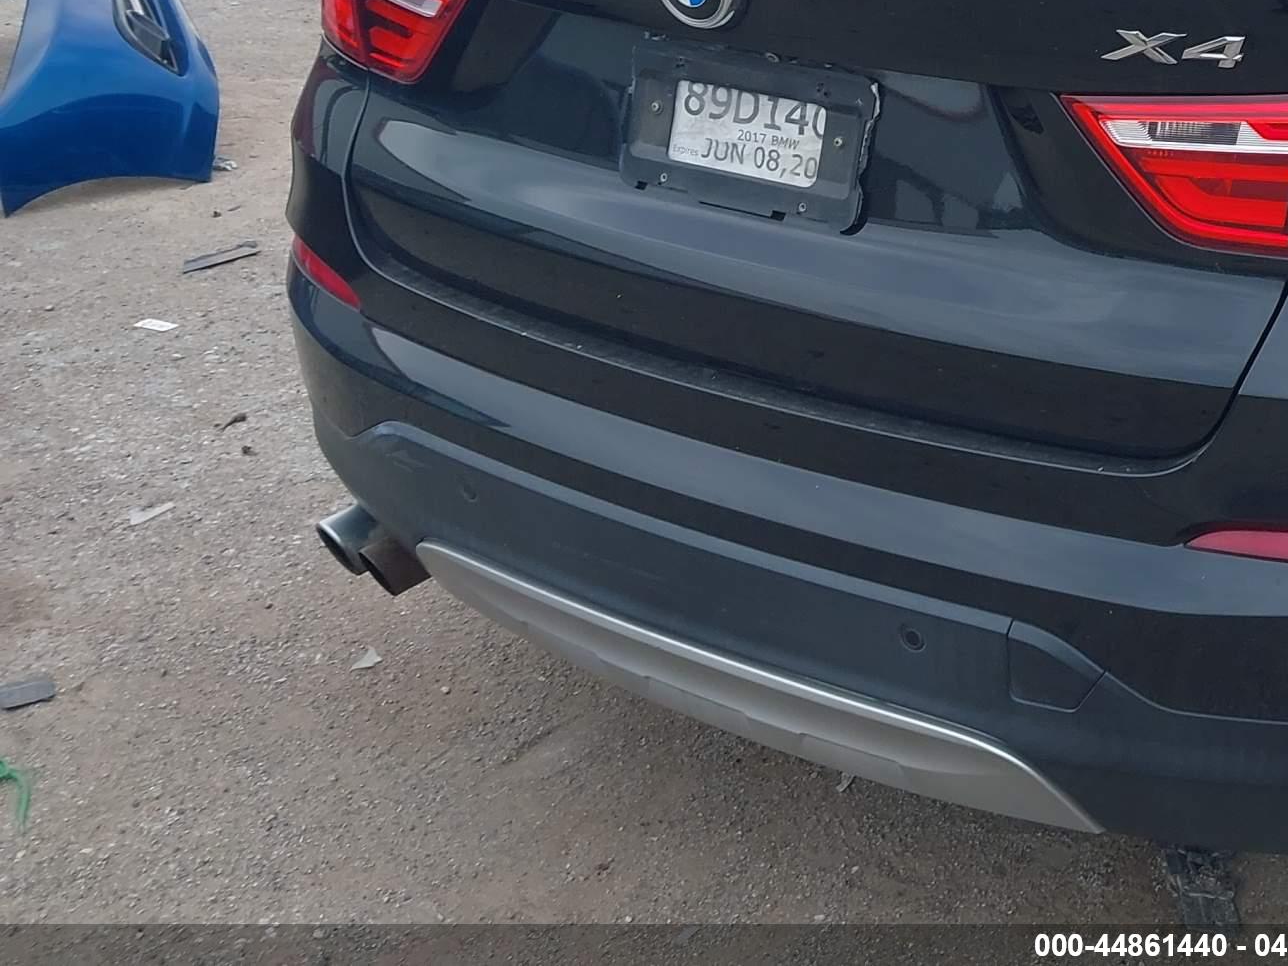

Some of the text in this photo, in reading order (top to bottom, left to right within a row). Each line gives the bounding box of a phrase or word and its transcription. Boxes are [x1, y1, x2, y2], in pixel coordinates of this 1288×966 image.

[1101, 29, 1246, 69] X4
[701, 138, 746, 165] JUN
[737, 129, 800, 150] 2017 BMW
